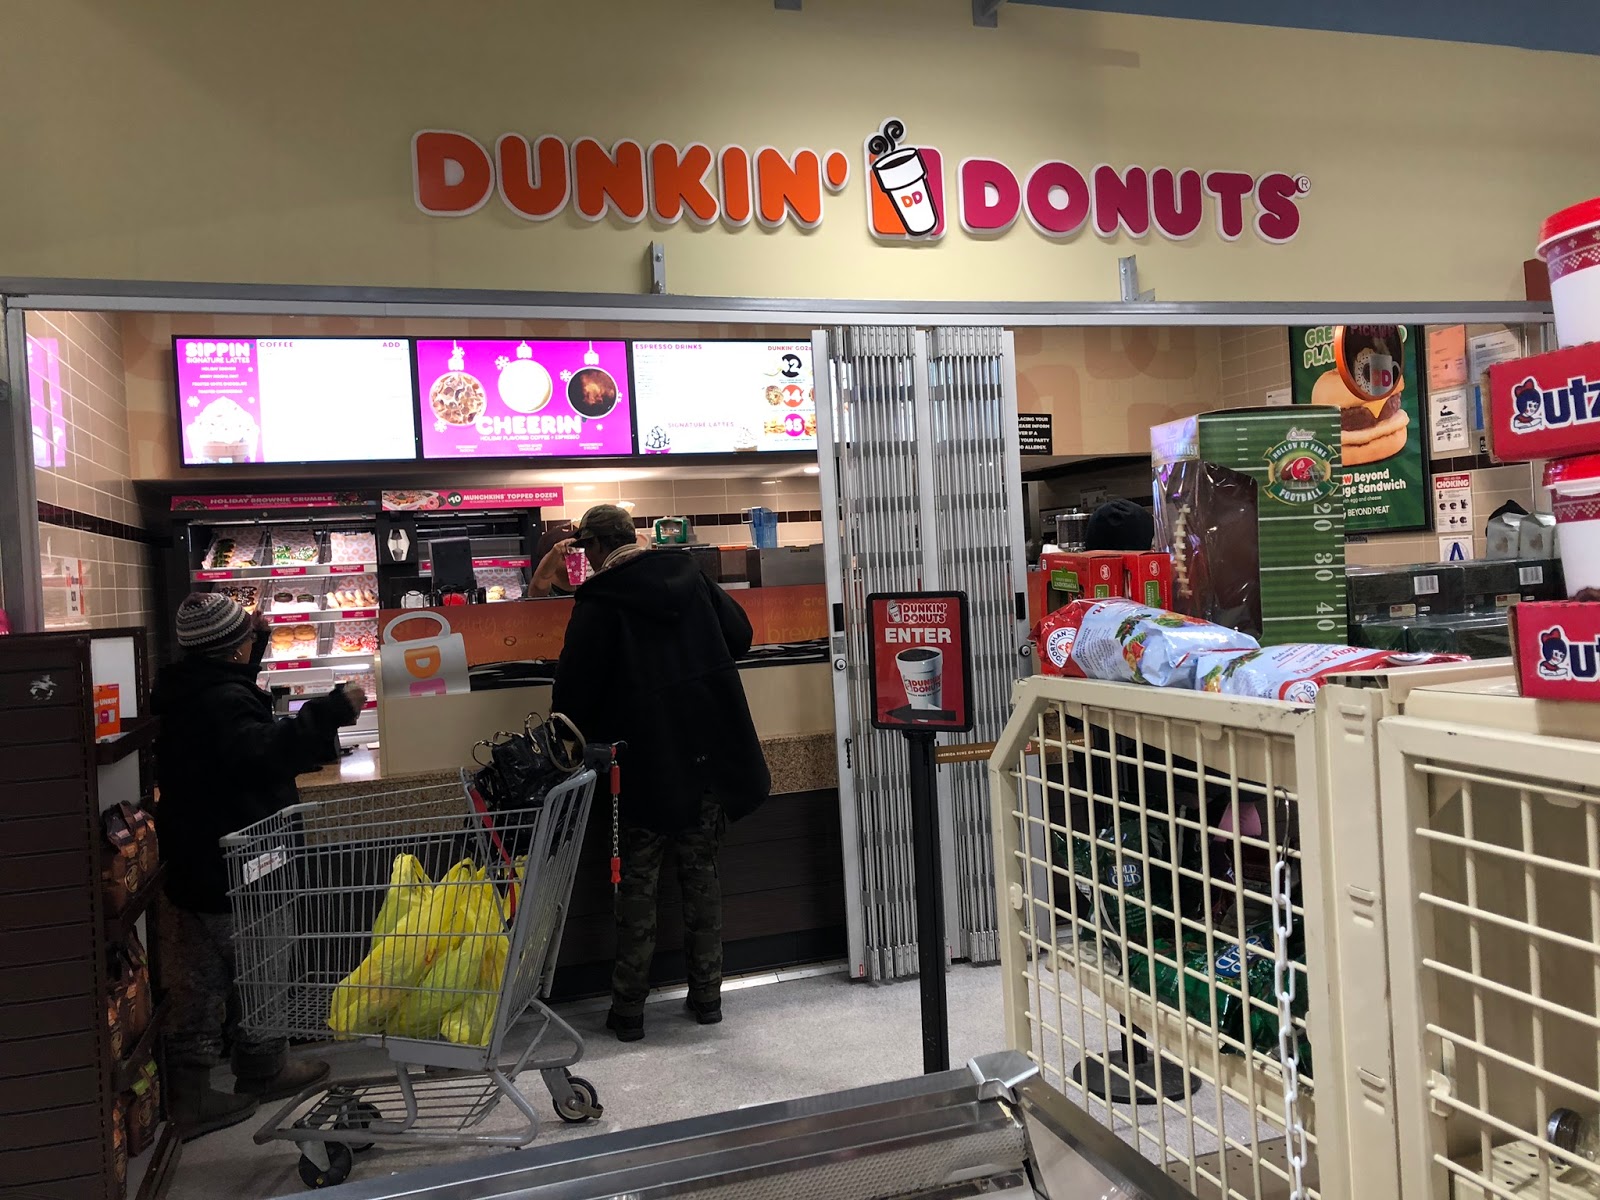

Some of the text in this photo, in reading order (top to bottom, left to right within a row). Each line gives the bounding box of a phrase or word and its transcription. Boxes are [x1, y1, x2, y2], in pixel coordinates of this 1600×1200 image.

[412, 129, 1302, 244] DUNKIN' DONUTS
[901, 191, 922, 208] DD
[1304, 326, 1335, 348] GRE
[185, 342, 250, 357] SIPPIN
[1303, 343, 1336, 369] PLA
[475, 414, 582, 435] CHEERIN
[1272, 442, 1298, 460] HOLLOW
[1300, 441, 1309, 449] OF
[1354, 468, 1390, 483] Beyond
[1358, 478, 1407, 494] Sandwich
[1436, 479, 1469, 489] CHOKING
[534, 491, 558, 499] DOZEN
[1279, 488, 1324, 502] FOOTBALL
[1347, 505, 1390, 517] BEYOND MEAT
[902, 602, 947, 613] DUNKIN'
[902, 613, 946, 623] DONUTS
[885, 627, 951, 643] ENTER
[1111, 864, 1137, 875] RLD
